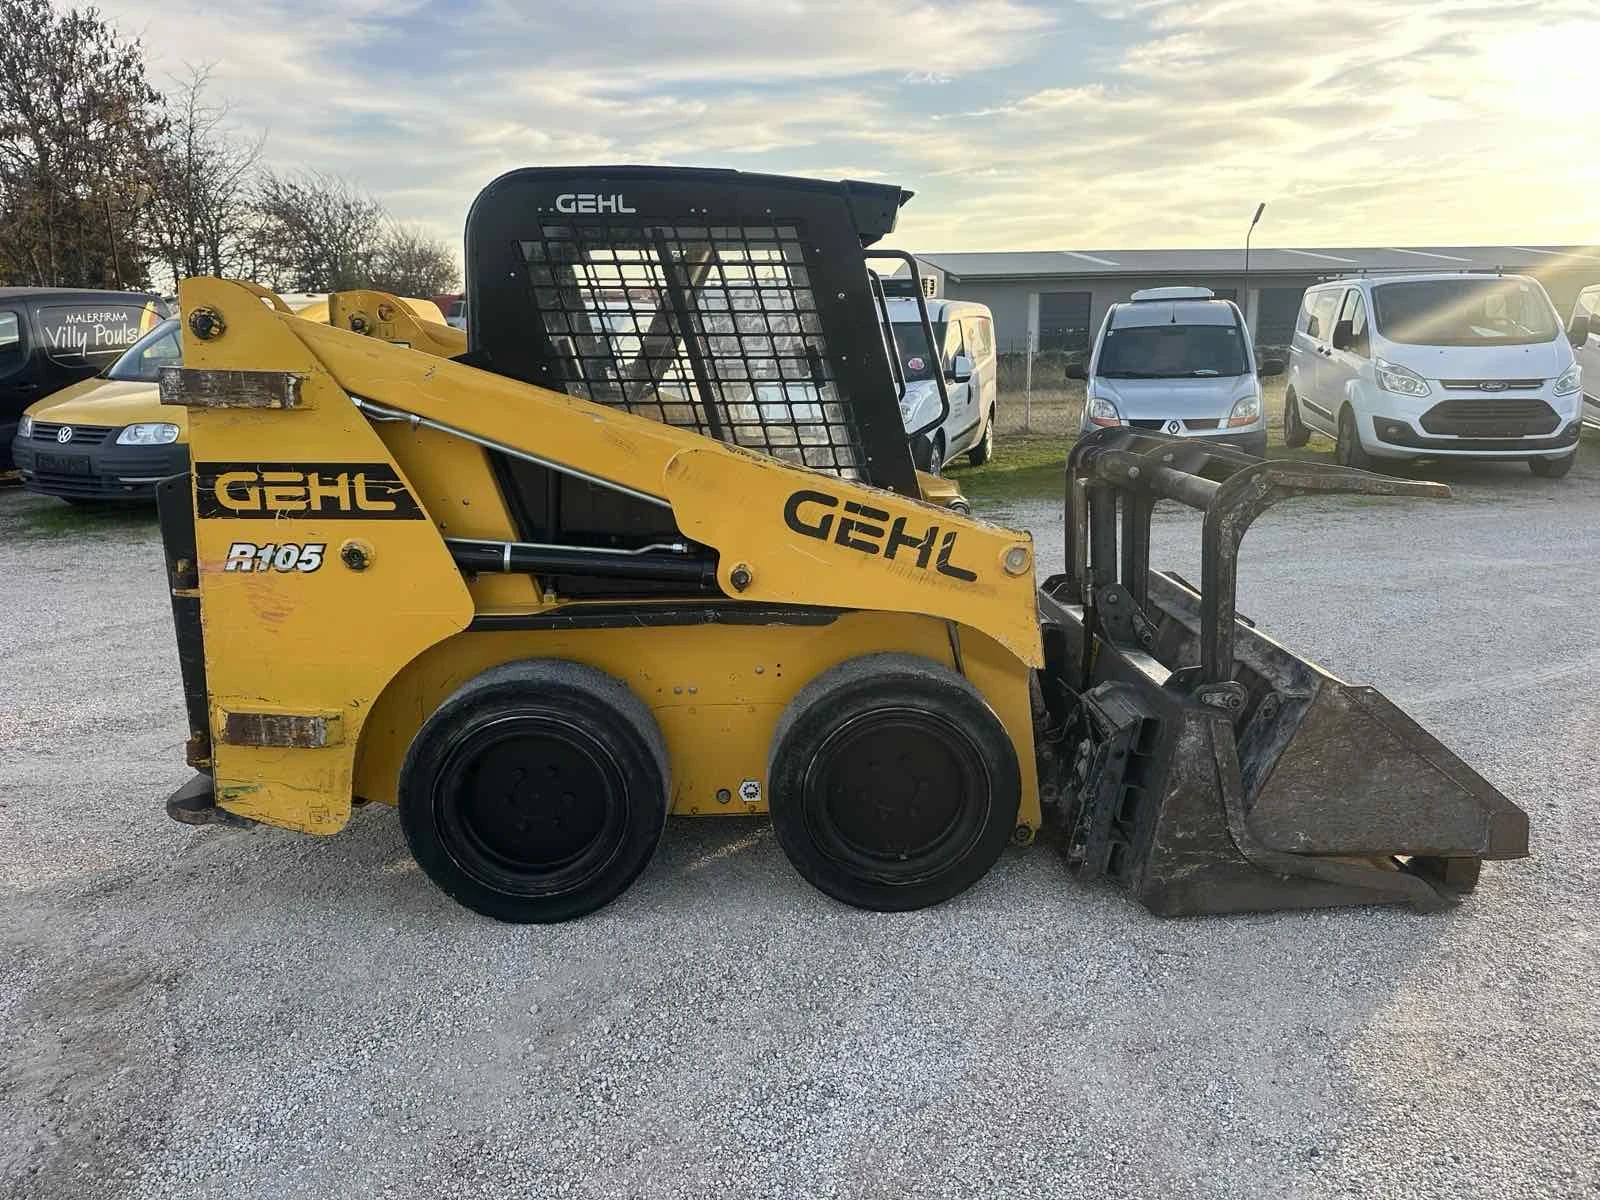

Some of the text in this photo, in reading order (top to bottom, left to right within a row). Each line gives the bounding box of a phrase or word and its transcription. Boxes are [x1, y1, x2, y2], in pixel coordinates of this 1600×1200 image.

[555, 193, 637, 214] GEHL
[65, 312, 128, 324] MALERFIRMA
[45, 325, 88, 357] Villy
[215, 471, 396, 511] GEHL
[783, 489, 978, 582] GEHL
[224, 543, 327, 573] R105
